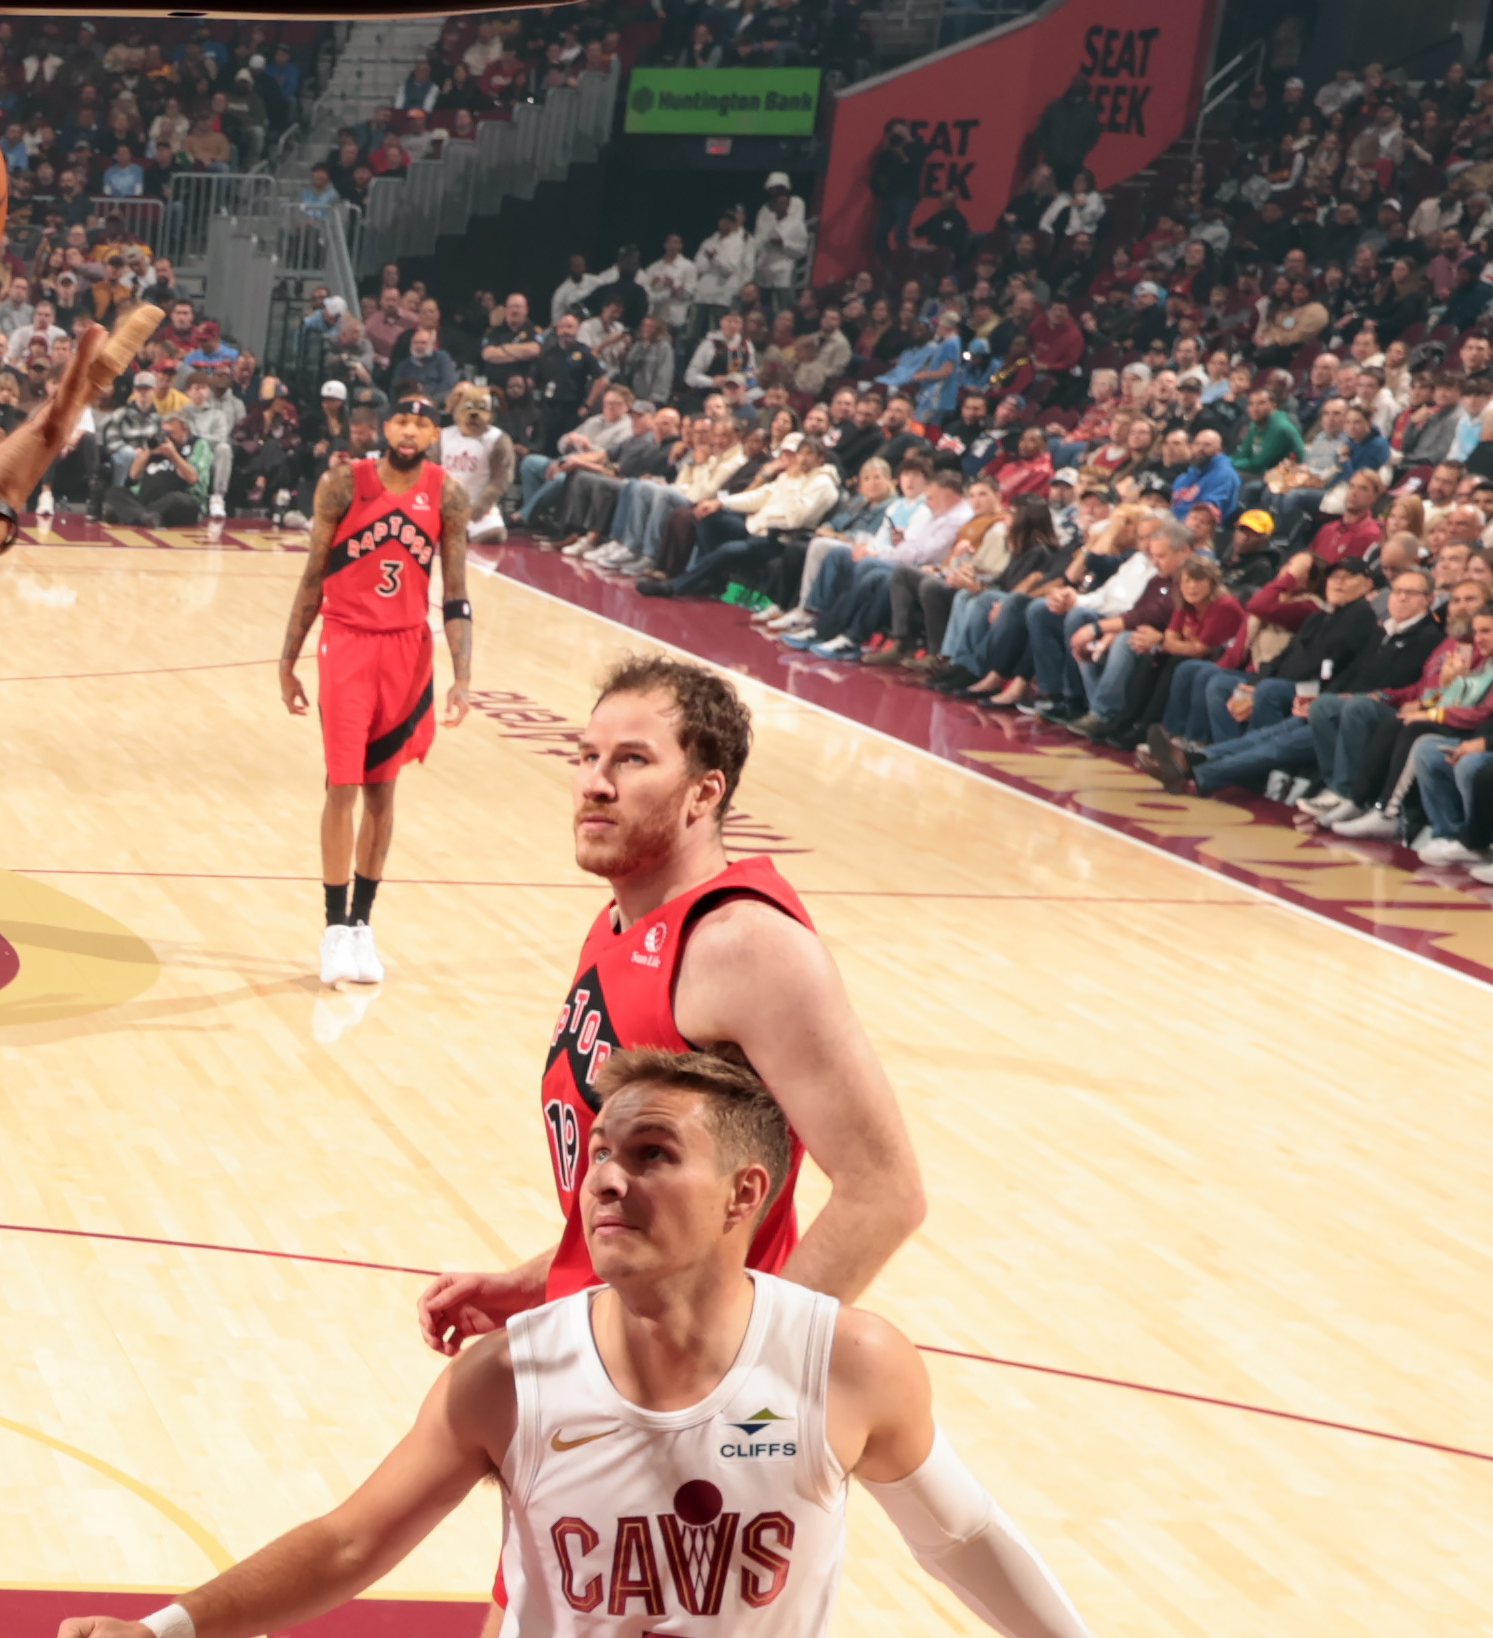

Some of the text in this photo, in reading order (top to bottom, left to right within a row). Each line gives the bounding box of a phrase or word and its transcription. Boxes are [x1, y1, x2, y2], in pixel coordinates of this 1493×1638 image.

[1080, 25, 1161, 78] SEAT
[657, 90, 812, 117] Huntington Bank
[1091, 85, 1155, 137] EEK
[347, 516, 433, 564] RAPTORS
[375, 560, 404, 597] 3
[544, 1099, 580, 1191] 19
[720, 1442, 797, 1458] CLIFFS
[550, 1509, 795, 1617] CAVS
